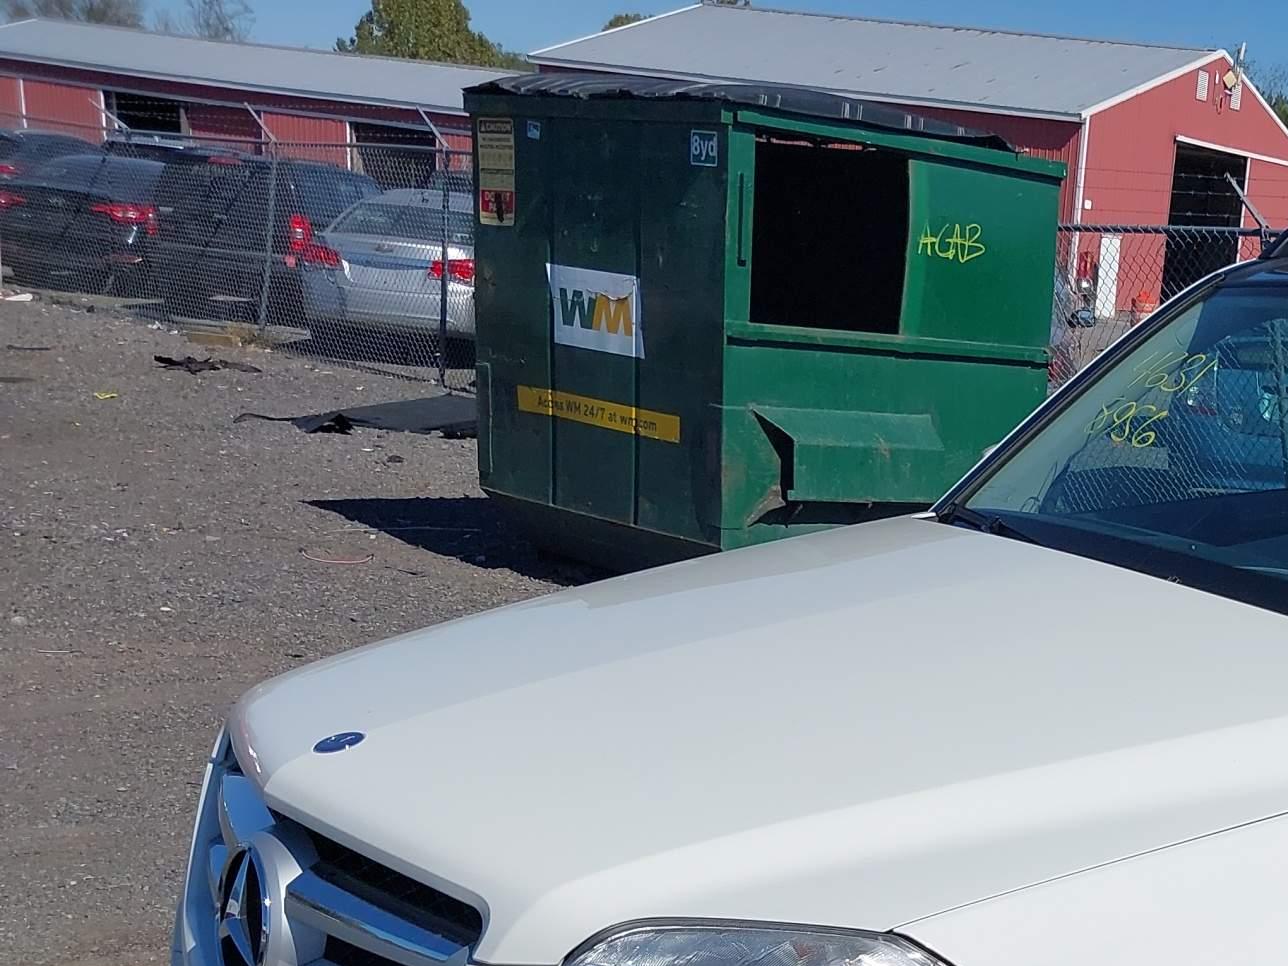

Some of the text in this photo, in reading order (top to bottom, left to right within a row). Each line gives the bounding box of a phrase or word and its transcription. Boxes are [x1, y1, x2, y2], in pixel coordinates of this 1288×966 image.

[692, 135, 716, 161] 8yd
[559, 287, 633, 337] WM
[566, 400, 582, 415] WM
[584, 403, 606, 420] 24/7
[608, 411, 618, 424] at
[620, 415, 657, 433] wmcom
